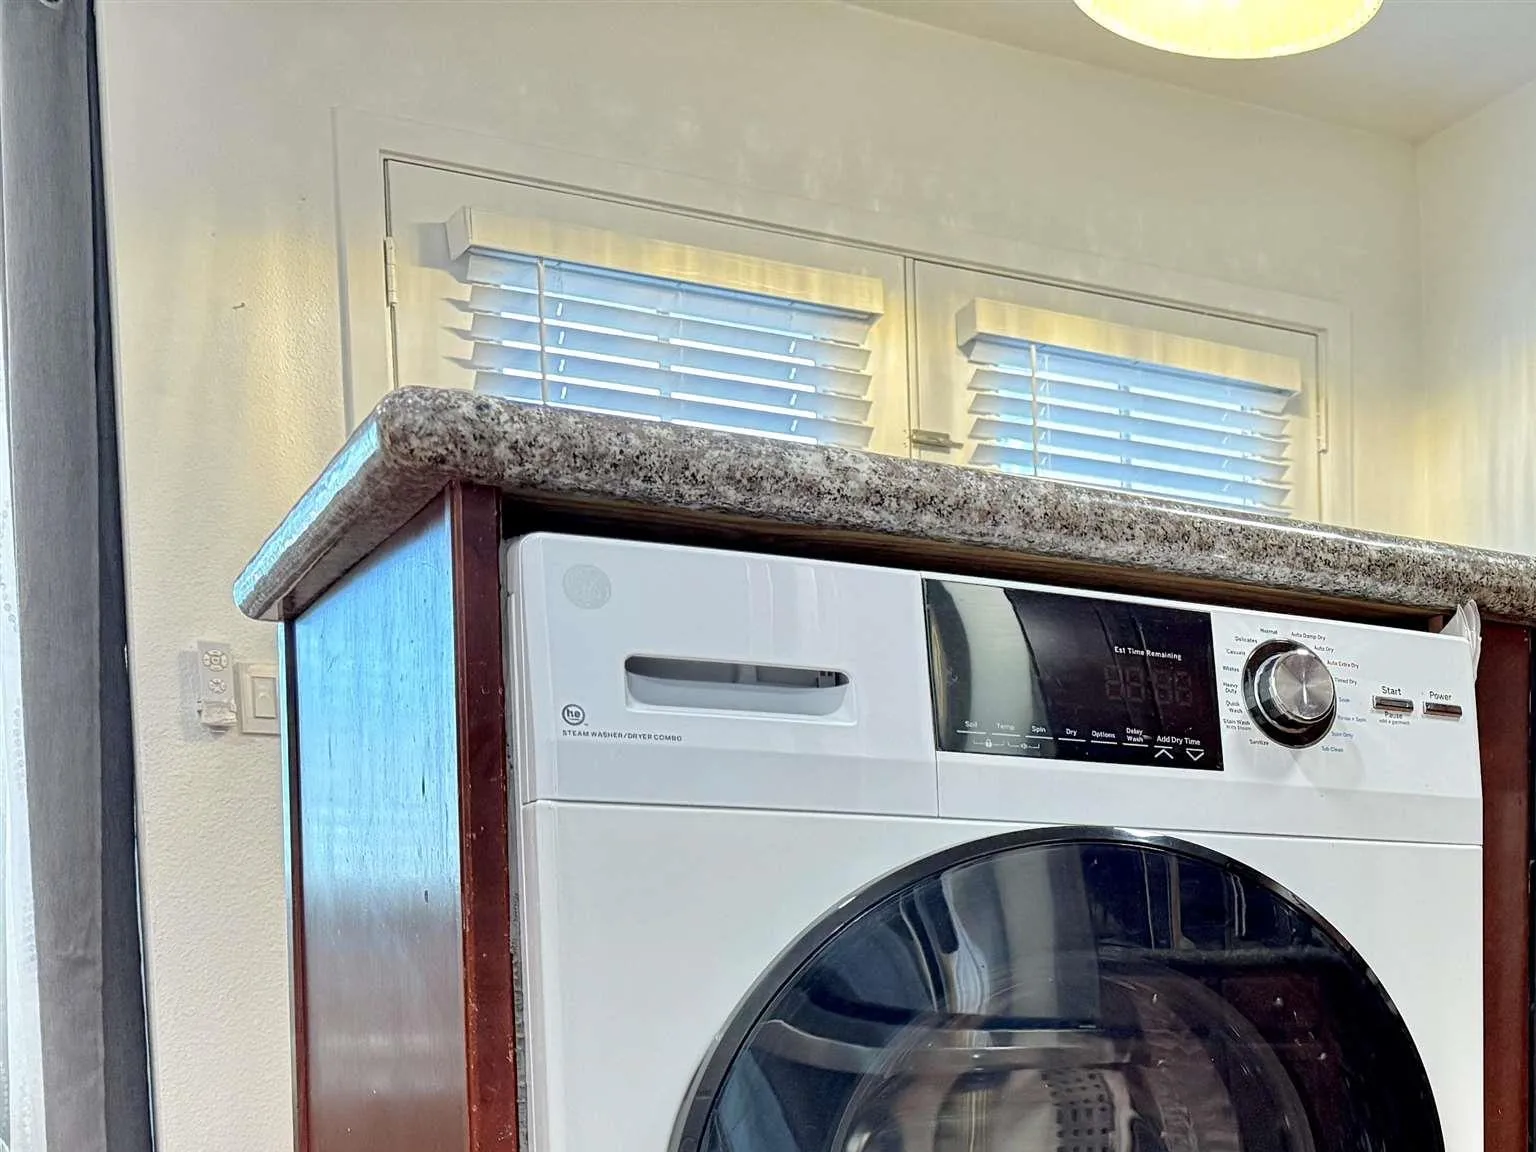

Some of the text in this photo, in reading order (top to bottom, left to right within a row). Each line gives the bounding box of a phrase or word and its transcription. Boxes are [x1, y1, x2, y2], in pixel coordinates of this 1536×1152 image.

[1114, 645, 1182, 661] Est Time Remaining
[1382, 685, 1402, 696] Start
[1429, 691, 1453, 701] Power
[1384, 711, 1403, 719] Pause
[964, 720, 978, 729] Soil
[562, 729, 590, 737] STEAM
[1031, 725, 1047, 735] Spin
[1065, 727, 1078, 737] Dry
[1091, 729, 1116, 740] Options
[1126, 727, 1143, 736] Delay
[1156, 735, 1201, 746] Add Dry Time
